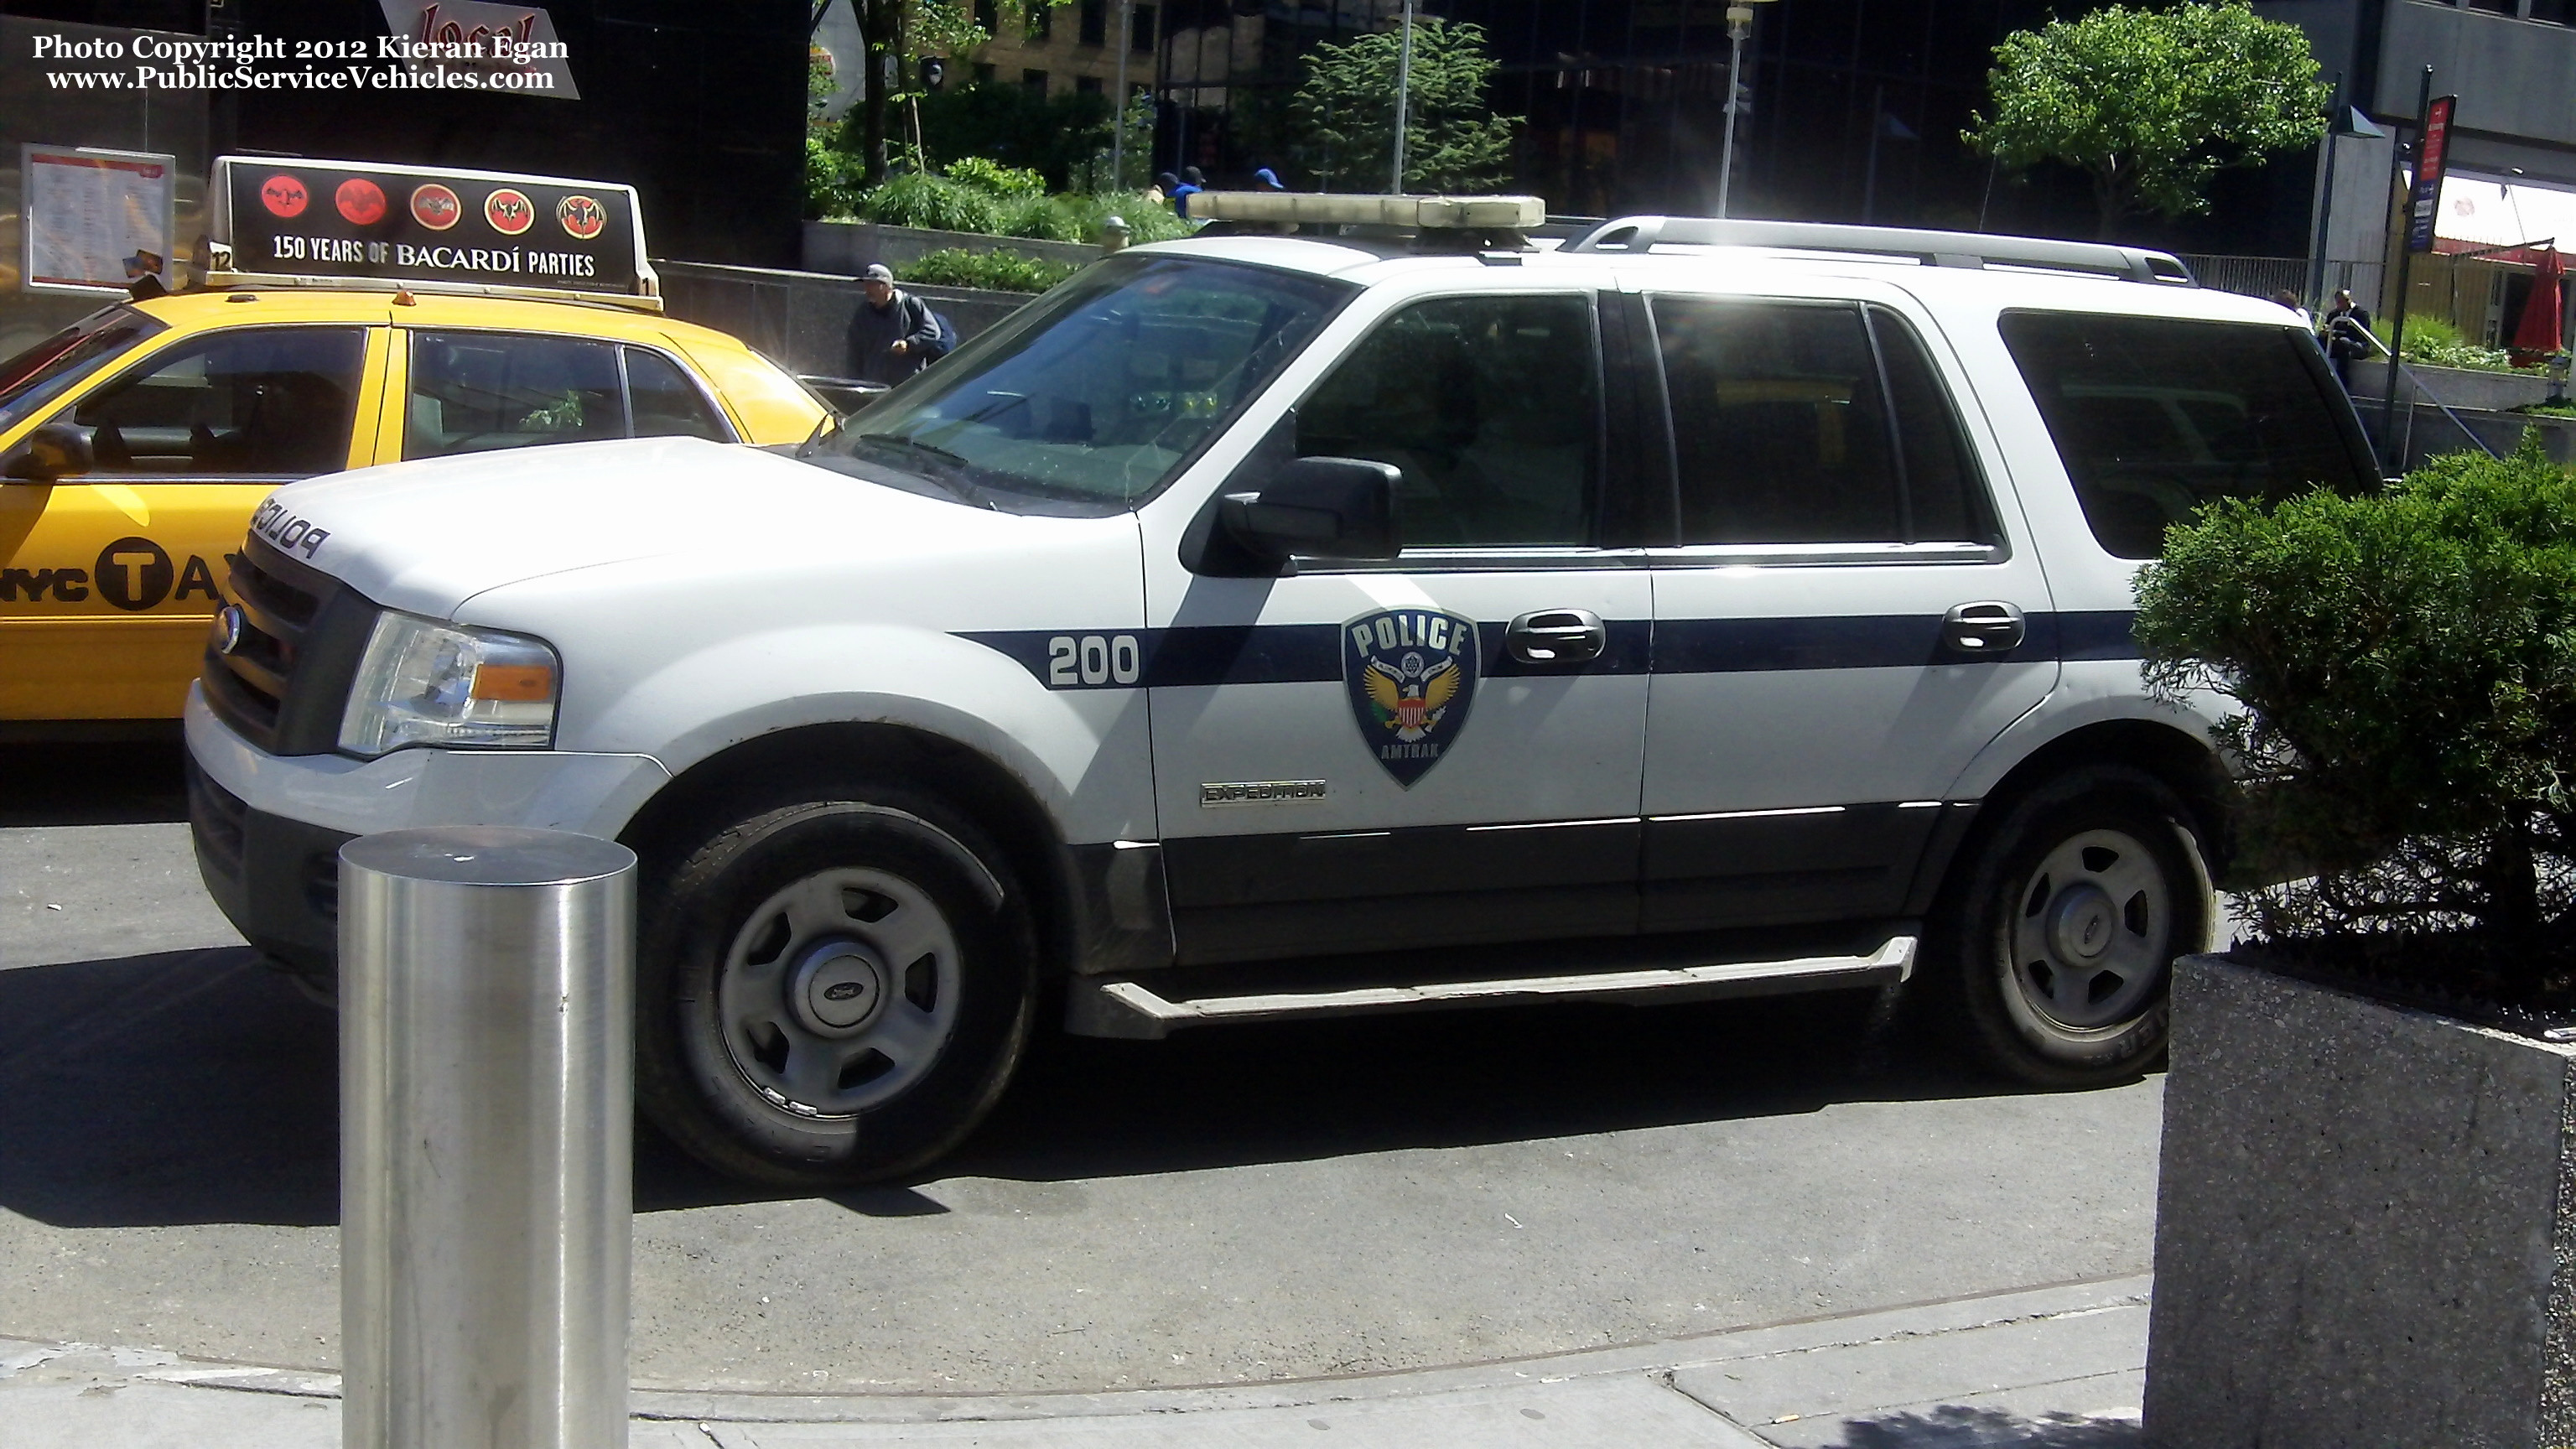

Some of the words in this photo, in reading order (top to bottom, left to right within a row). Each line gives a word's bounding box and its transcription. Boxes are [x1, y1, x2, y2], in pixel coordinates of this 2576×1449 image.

[273, 235, 305, 260] 150
[310, 237, 363, 262] YEARS
[367, 242, 390, 263] OF
[395, 243, 521, 273] BACARDÍ
[527, 251, 595, 277] PARTIES
[1351, 614, 1467, 658] POLICE
[1048, 635, 1140, 685] 200
[1381, 743, 1439, 760] AMTRAK
[1202, 782, 1325, 801] EXPEDITION
